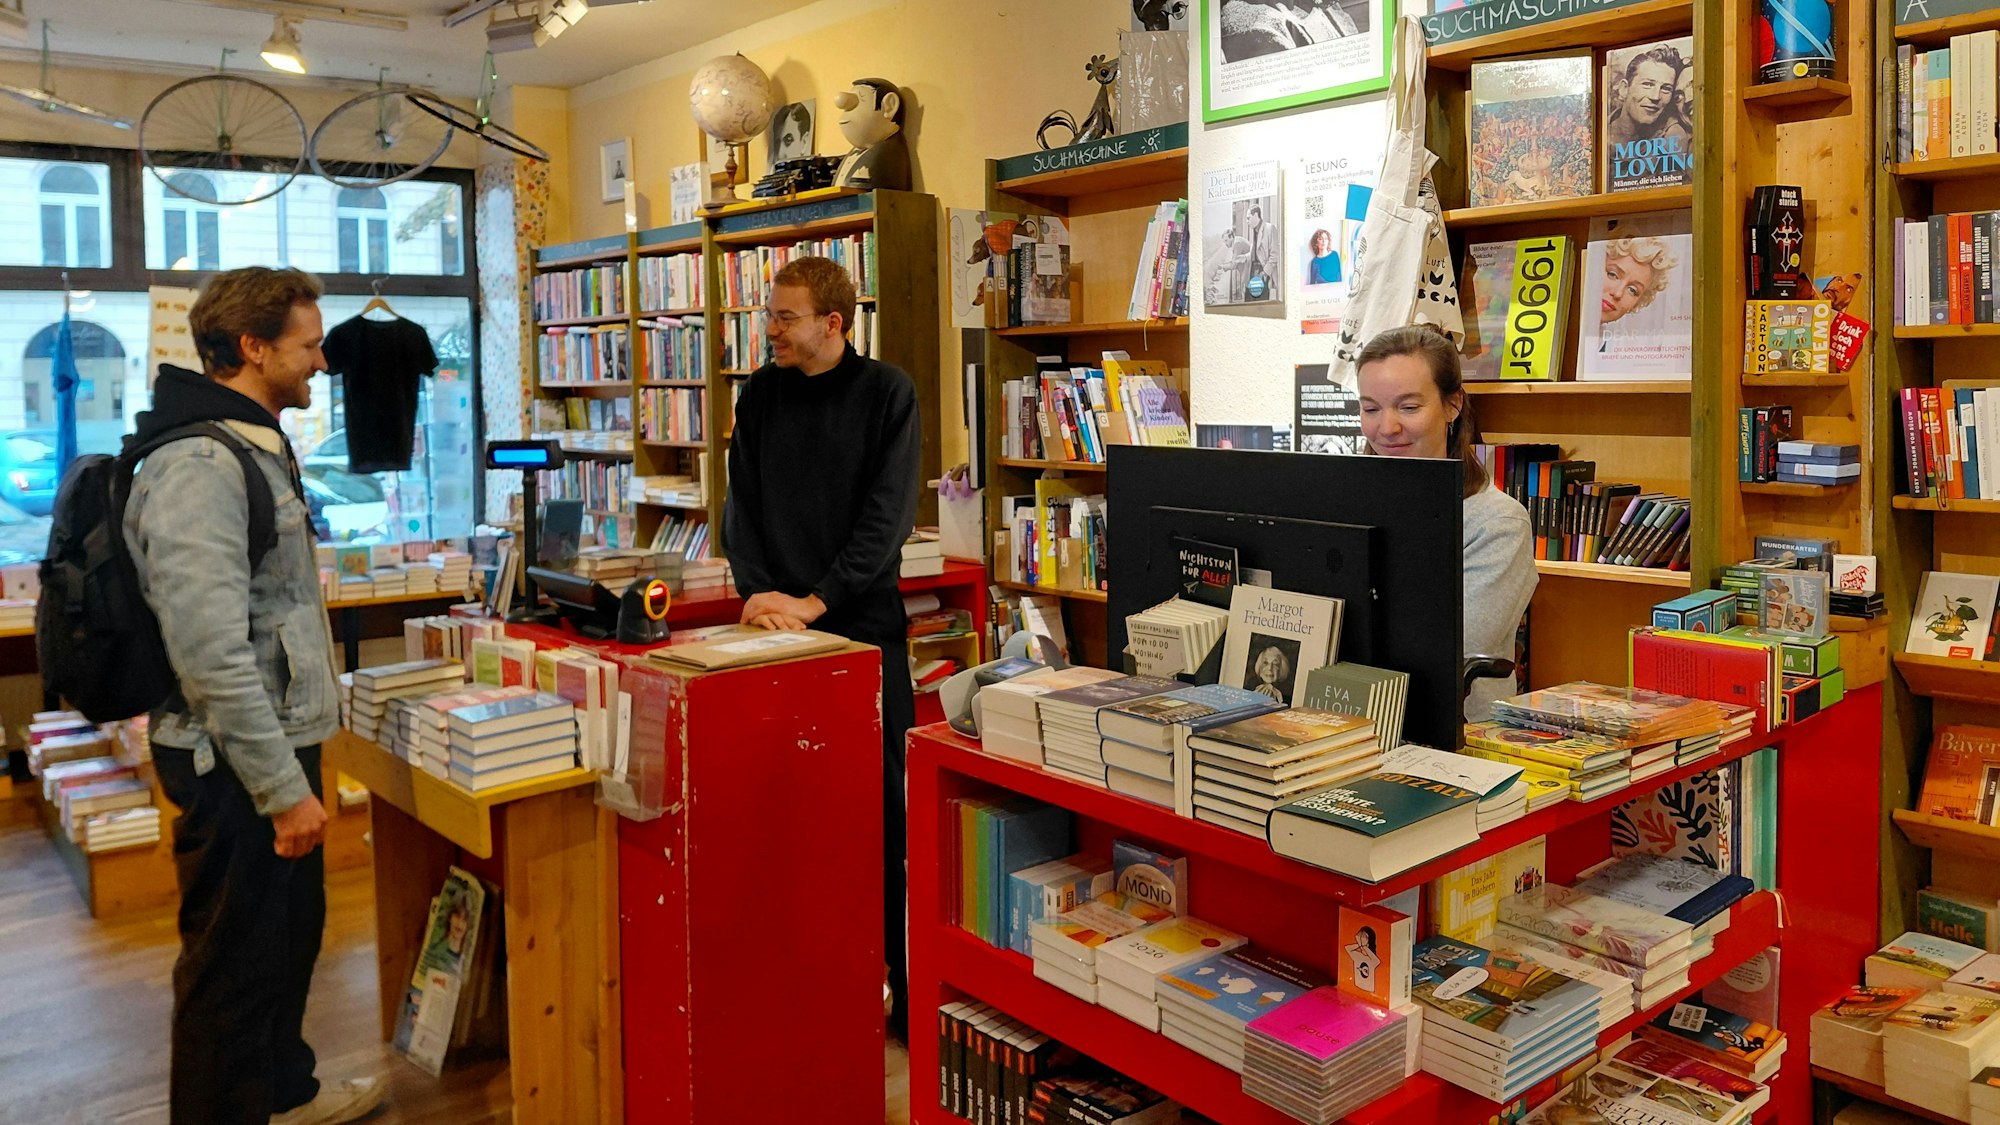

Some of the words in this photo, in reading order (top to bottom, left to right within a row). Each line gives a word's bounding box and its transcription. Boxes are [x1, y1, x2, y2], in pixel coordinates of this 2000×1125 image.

[1033, 141, 1127, 172] SUCHMASCHINE
[1615, 136, 1682, 161] MORE
[1305, 158, 1348, 174] LESUNG
[1210, 175, 1227, 188] Der
[1229, 170, 1267, 183] Literatur
[1613, 180, 1639, 188] Männer,
[1649, 176, 1663, 184] sich
[1663, 175, 1683, 183] lieben
[1207, 185, 1246, 199] Kalender
[1781, 189, 1797, 199] black
[1778, 198, 1799, 207] stories
[1981, 236, 1990, 253] NACHT
[1426, 255, 1446, 269] Lust
[1982, 254, 1990, 263] DIE
[1168, 263, 1175, 273] C
[1982, 263, 1990, 271] IST
[986, 280, 993, 288] A
[999, 279, 1005, 287] B
[1982, 271, 1990, 290] SCHÖN
[1509, 239, 1556, 375] 1990er
[1602, 329, 1638, 343] DEAR
[1812, 303, 1829, 372] MEMO
[1838, 320, 1863, 339] Drink
[1758, 304, 1767, 372] CARTOON
[1100, 415, 1107, 424] G
[1741, 414, 1750, 432] HAPPY
[1741, 432, 1750, 455] CAMPER
[1761, 541, 1817, 553] WUNDERKARTEN
[1180, 550, 1232, 571] NICHTSTUN
[1182, 564, 1199, 577] FÜR
[1202, 569, 1231, 585] ALLE!
[1257, 597, 1304, 617] Margot
[1161, 626, 1179, 635] SMITH
[1244, 610, 1314, 635] Friedländer
[1132, 637, 1146, 646] HOW
[1147, 638, 1156, 647] TO
[1158, 640, 1168, 649] DO
[1134, 649, 1164, 660] NOTHING
[1325, 685, 1350, 701] EVA
[1309, 699, 1361, 716] ILLOUZ
[1319, 790, 1376, 807] KÖNNTE
[1329, 786, 1354, 796] WIE
[1424, 783, 1474, 799] ALY
[1305, 797, 1336, 810] DAS
[1292, 799, 1387, 827] GESCHEHEN?
[1471, 876, 1483, 886] Das
[1483, 870, 1496, 883] Jahr
[1125, 876, 1172, 906] MOND
[1463, 891, 1470, 901] in
[1471, 882, 1496, 898] Büchern
[1131, 942, 1163, 959] 2026
[1297, 1022, 1341, 1046] pause
